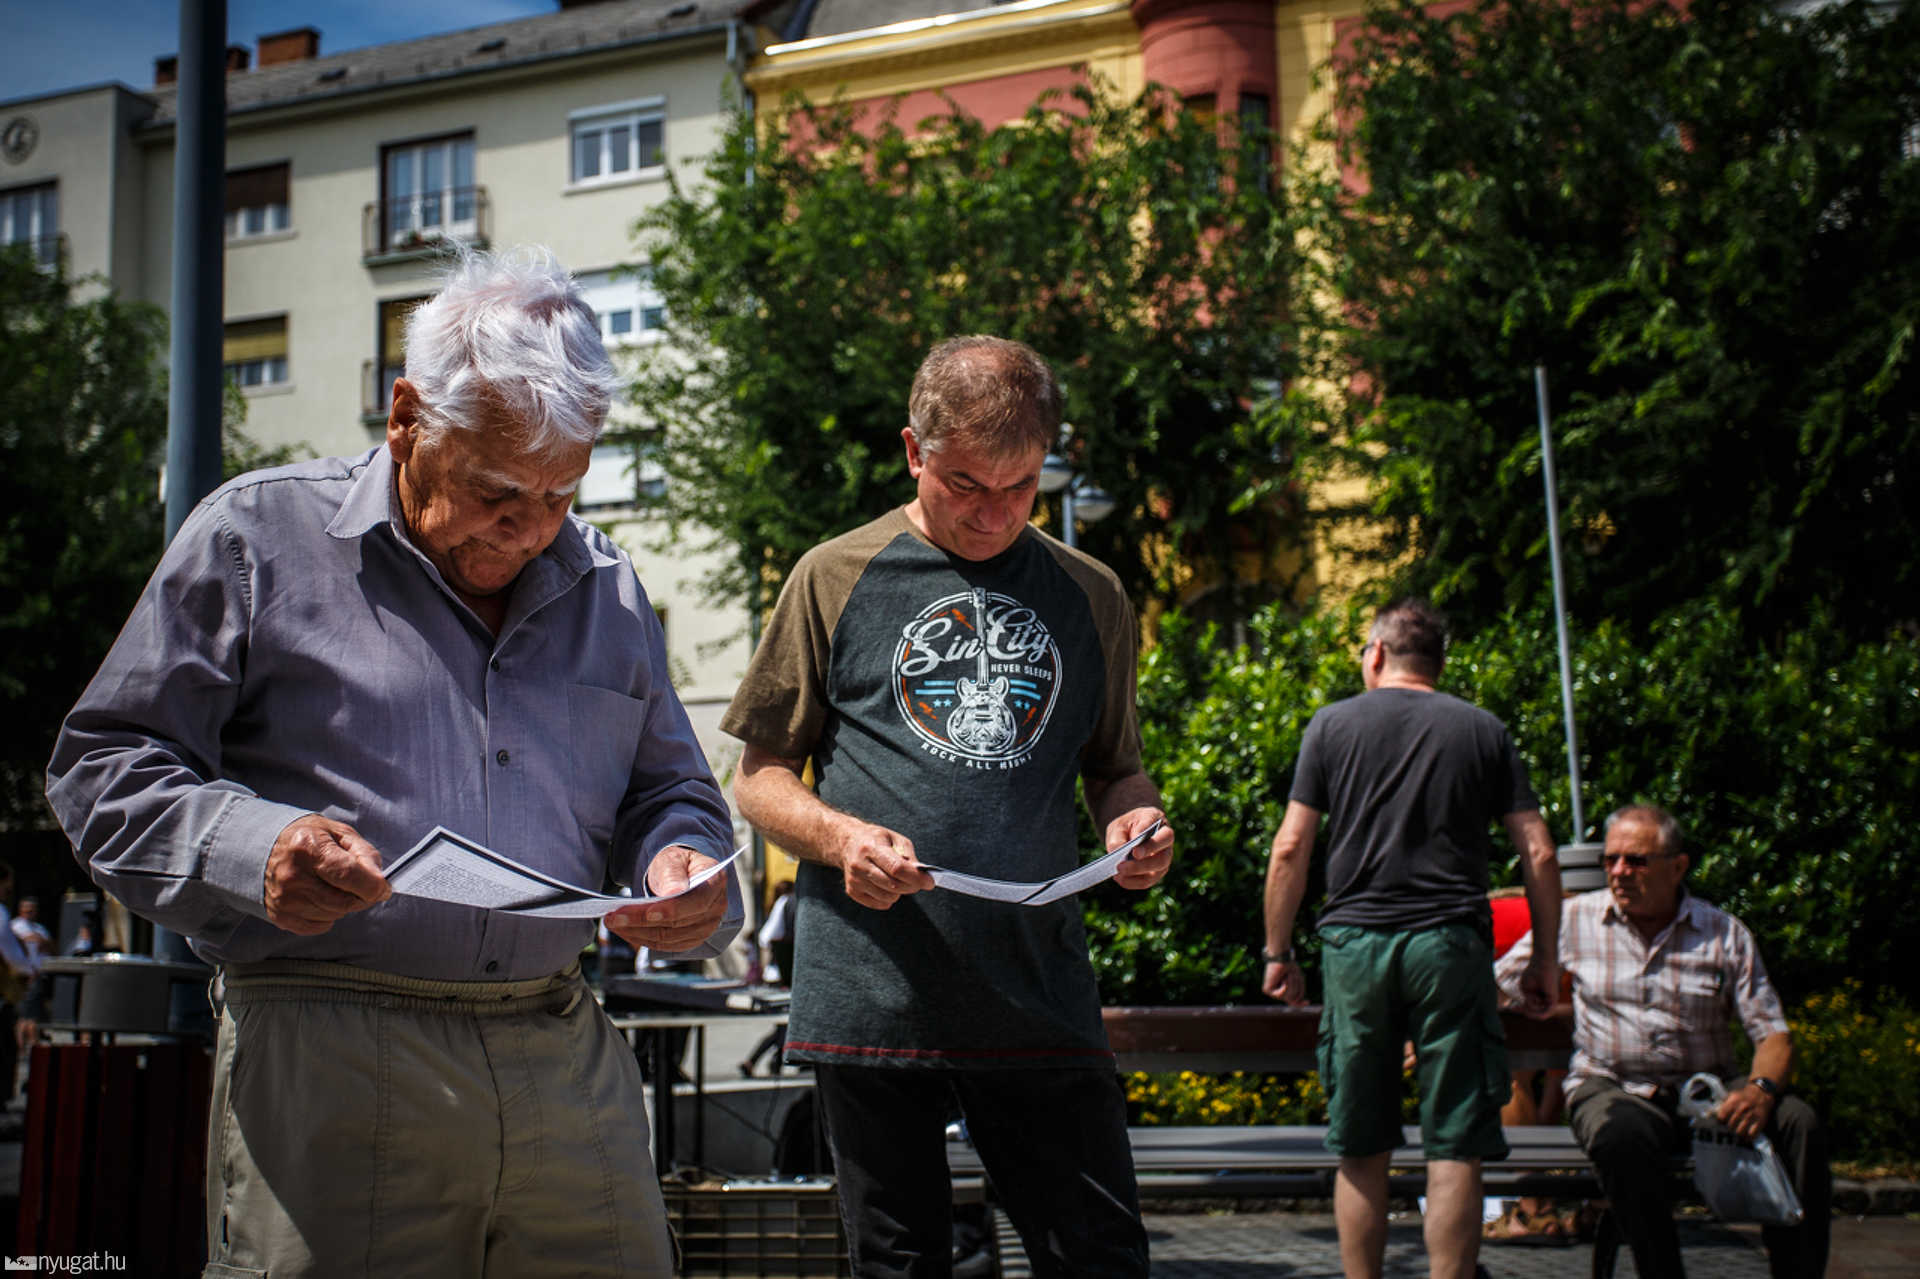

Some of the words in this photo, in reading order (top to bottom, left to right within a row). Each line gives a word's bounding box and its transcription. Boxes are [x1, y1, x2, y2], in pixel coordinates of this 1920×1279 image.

[900, 617, 983, 677] Sin
[986, 605, 1051, 663] City
[991, 663, 1021, 673] NEVER
[1024, 665, 1053, 681] SLEEPS
[921, 742, 957, 763] ROCK
[966, 759, 992, 770] ALL
[1000, 752, 1033, 770] NIGHT
